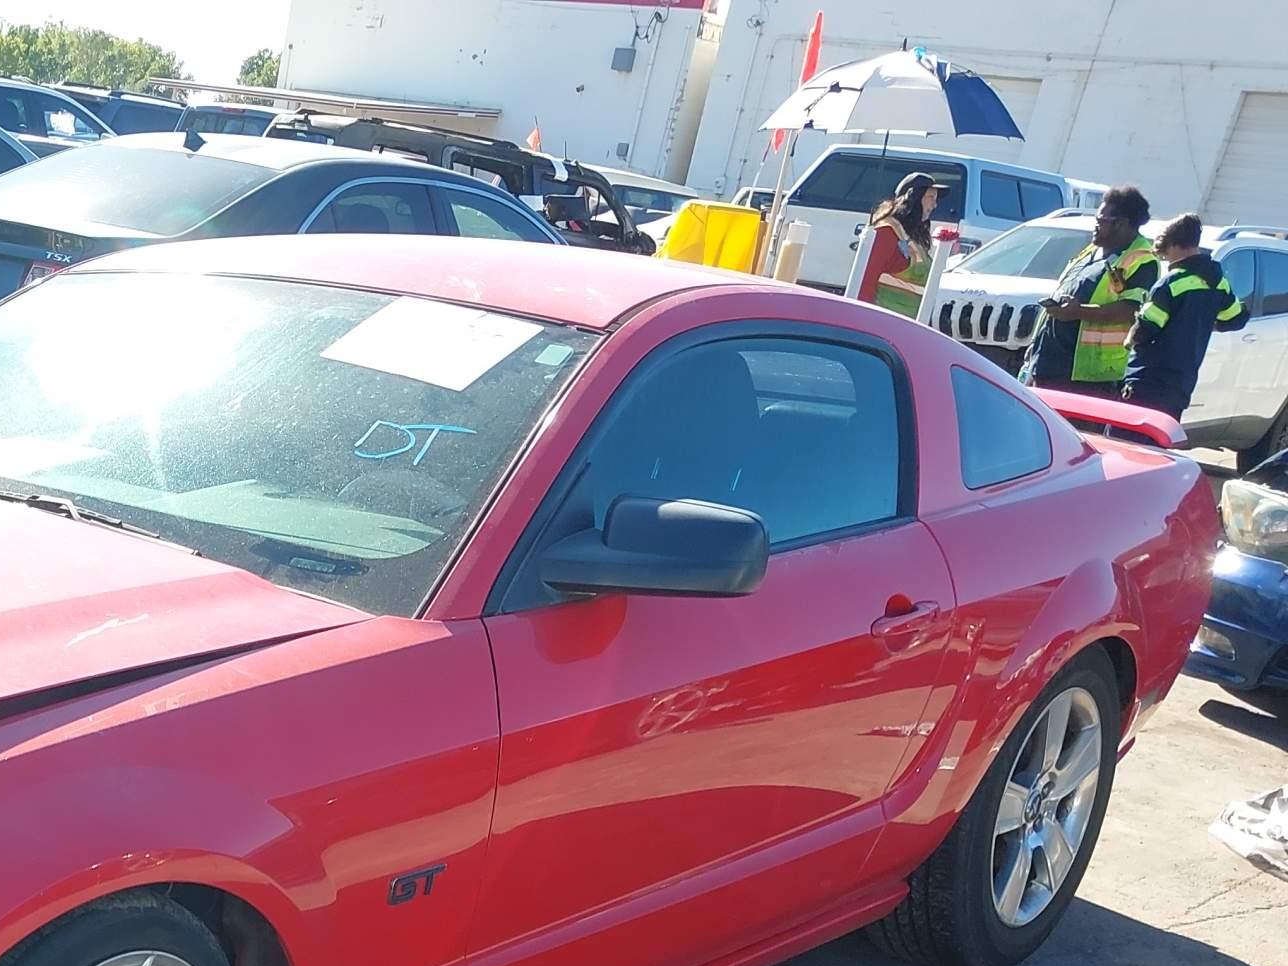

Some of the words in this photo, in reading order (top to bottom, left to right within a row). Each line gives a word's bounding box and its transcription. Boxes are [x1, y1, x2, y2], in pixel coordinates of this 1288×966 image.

[45, 251, 72, 263] TSX
[354, 420, 478, 466] DT
[388, 863, 447, 906] GT
